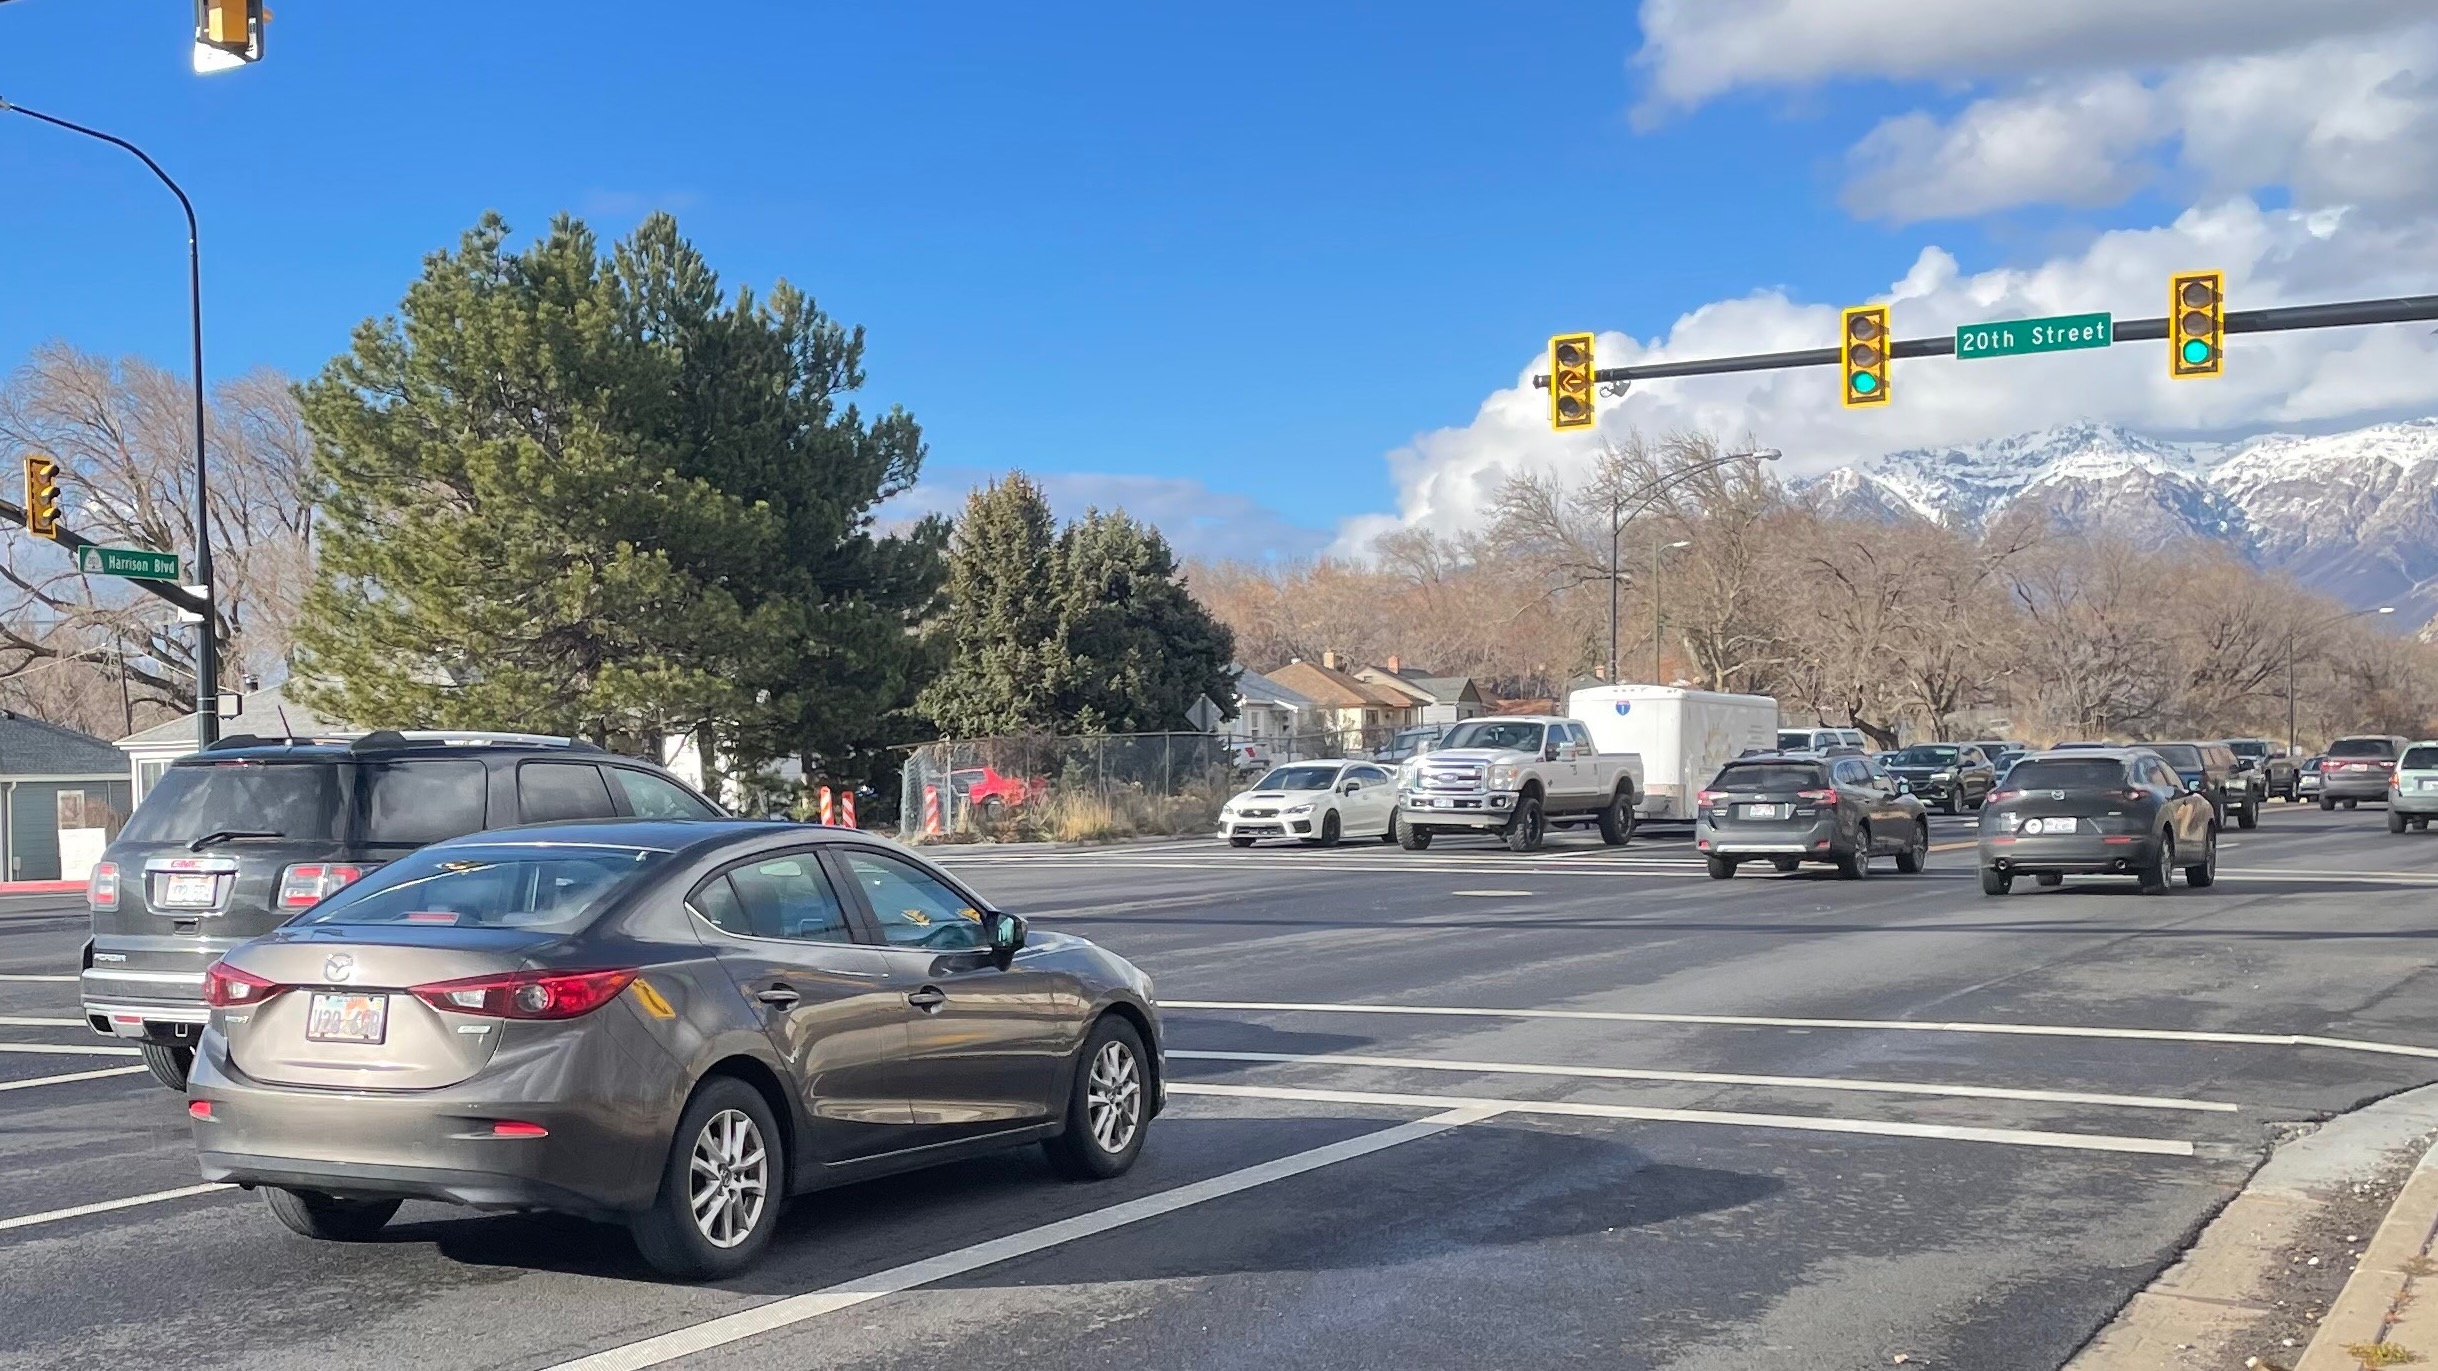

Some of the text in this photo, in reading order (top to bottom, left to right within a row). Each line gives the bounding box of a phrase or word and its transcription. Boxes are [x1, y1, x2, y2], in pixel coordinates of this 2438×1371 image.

[1963, 321, 2104, 351] 20th Street
[108, 555, 174, 573] Harrison Blvd
